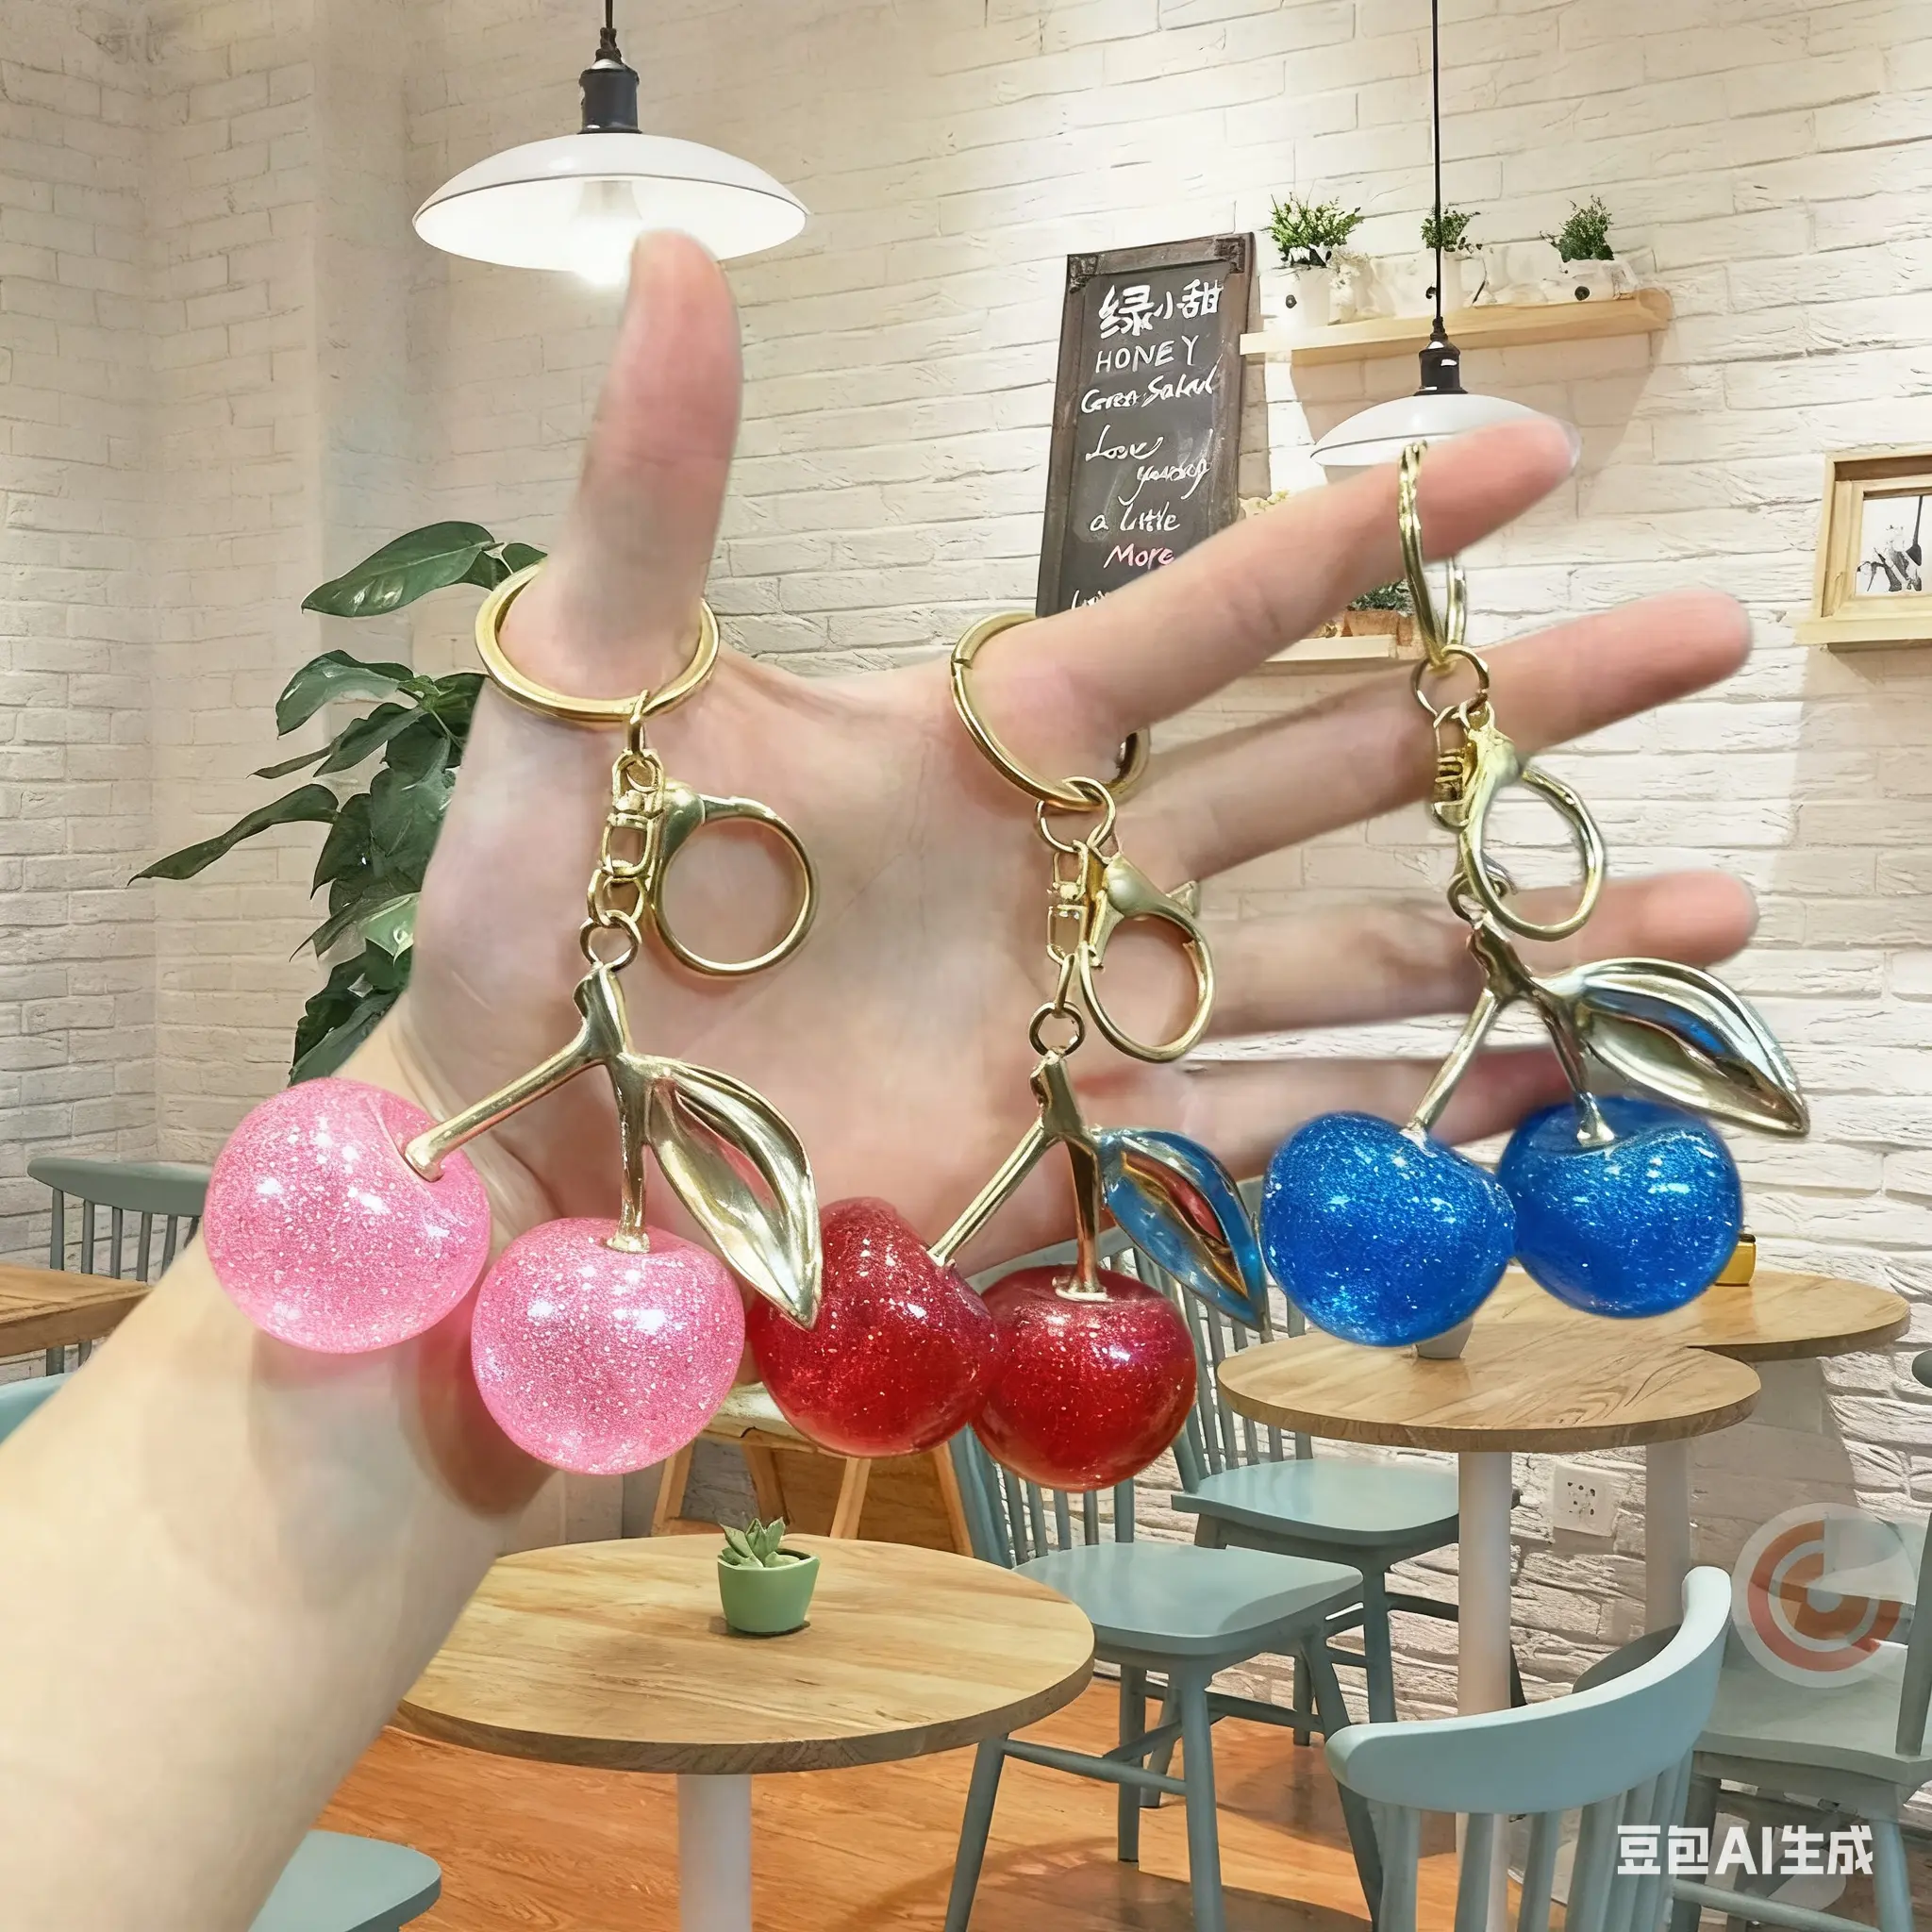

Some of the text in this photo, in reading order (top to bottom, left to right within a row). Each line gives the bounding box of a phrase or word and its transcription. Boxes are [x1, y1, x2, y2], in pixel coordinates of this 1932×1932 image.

[1097, 278, 1224, 340] 绿小甜
[1095, 335, 1199, 374] HONEY
[1090, 514, 1109, 532] a
[1104, 543, 1174, 569] More
